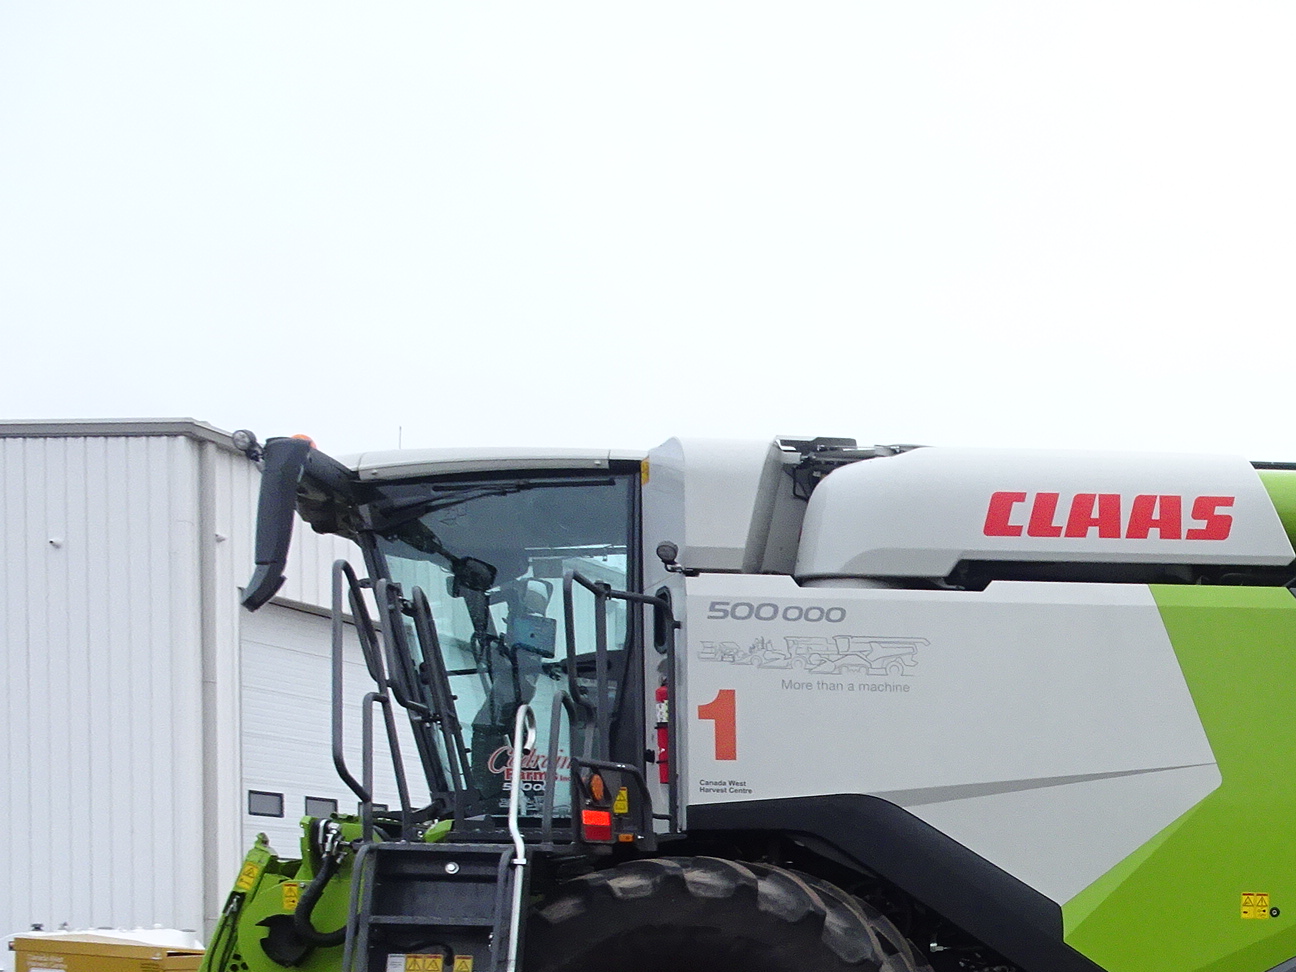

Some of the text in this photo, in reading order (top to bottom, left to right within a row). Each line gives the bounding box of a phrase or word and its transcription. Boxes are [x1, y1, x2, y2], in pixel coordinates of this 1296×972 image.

[983, 491, 1235, 541] CLAAS
[781, 679, 911, 693] More than a machine
[697, 689, 737, 761] 1
